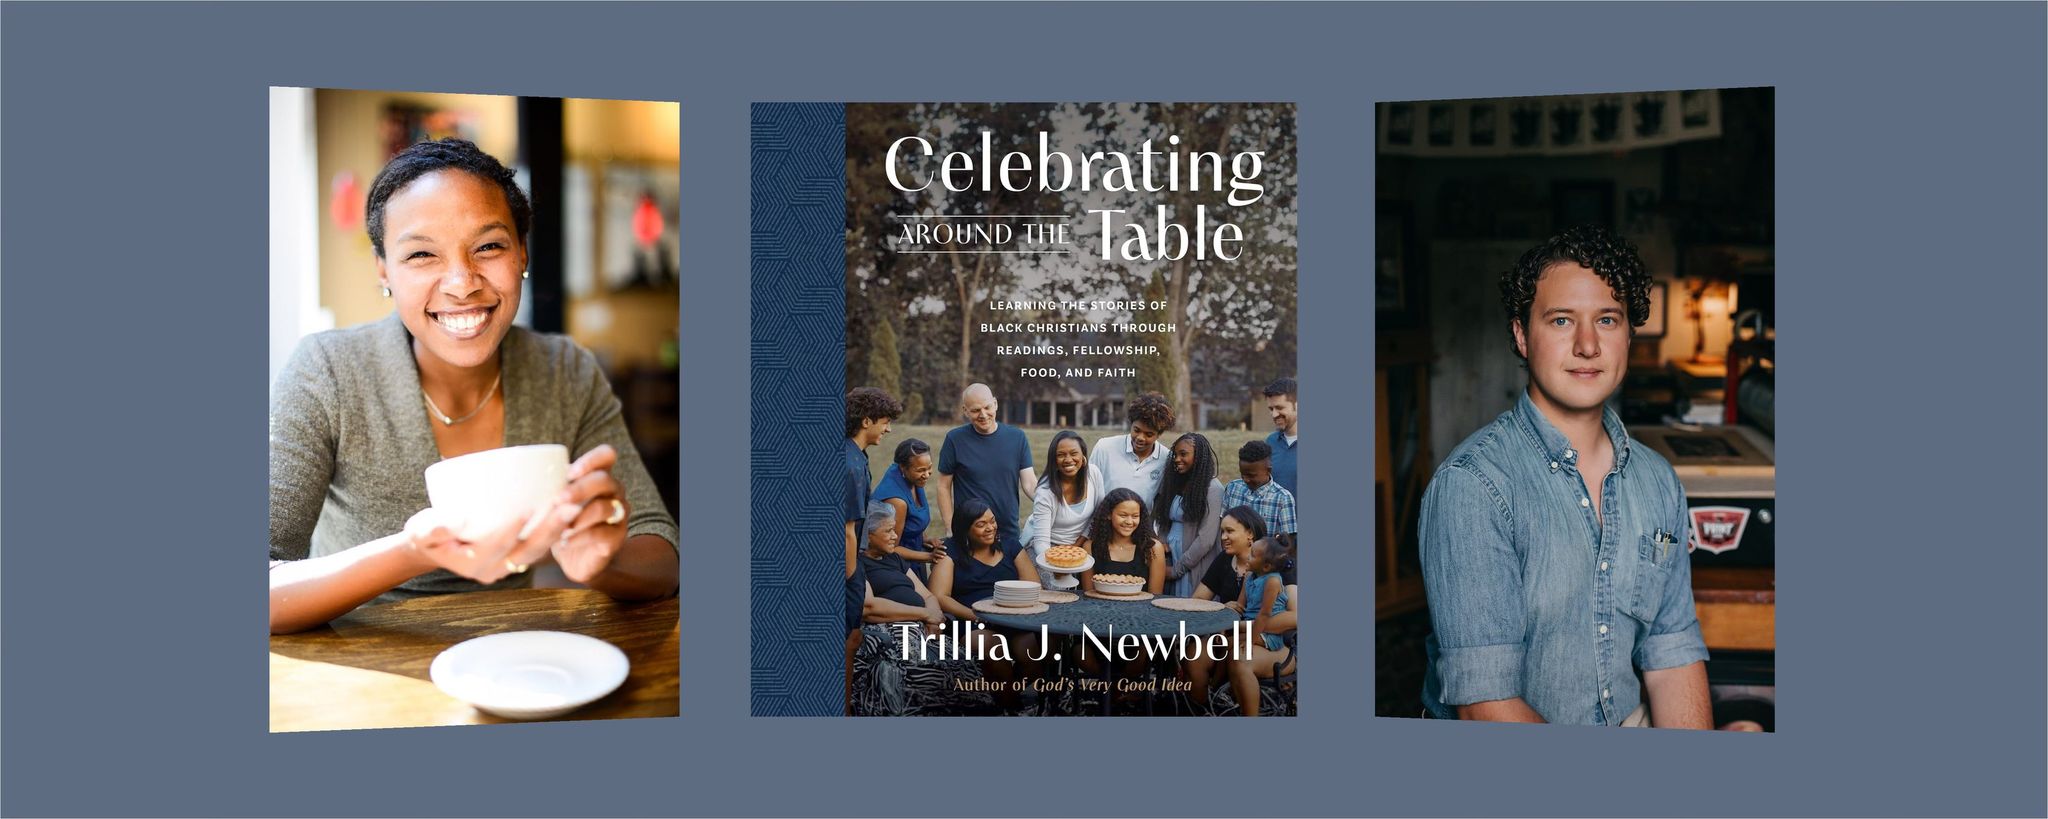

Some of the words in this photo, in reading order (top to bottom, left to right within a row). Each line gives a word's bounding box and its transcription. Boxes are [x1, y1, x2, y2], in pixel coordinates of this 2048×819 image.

[885, 131, 1265, 207] Celebrating
[898, 224, 1013, 245] AROUND
[1022, 224, 1069, 245] THE
[1088, 205, 1243, 261] Table
[989, 301, 1057, 311] LEARNING
[1061, 301, 1086, 311] THE
[1090, 300, 1145, 311] STORIES
[1150, 300, 1167, 311] OF
[980, 322, 1023, 334] BLACK
[1027, 322, 1107, 334] CHRISTIANS
[1111, 322, 1176, 334] THROUGH
[997, 345, 1069, 357] READINGS,
[1073, 345, 1160, 357] FELLOWSHIP,
[1020, 367, 1061, 379] FOOD,
[1065, 367, 1093, 378] AND
[1098, 367, 1135, 378] FAITH
[892, 620, 1013, 661] Trillia
[1027, 623, 1061, 661] J.
[1081, 620, 1253, 662] Newbell
[953, 678, 1007, 691] Author
[1012, 677, 1027, 691] of
[1079, 678, 1112, 694] Very
[1117, 677, 1155, 693] Good
[1161, 677, 1192, 691] Idea
